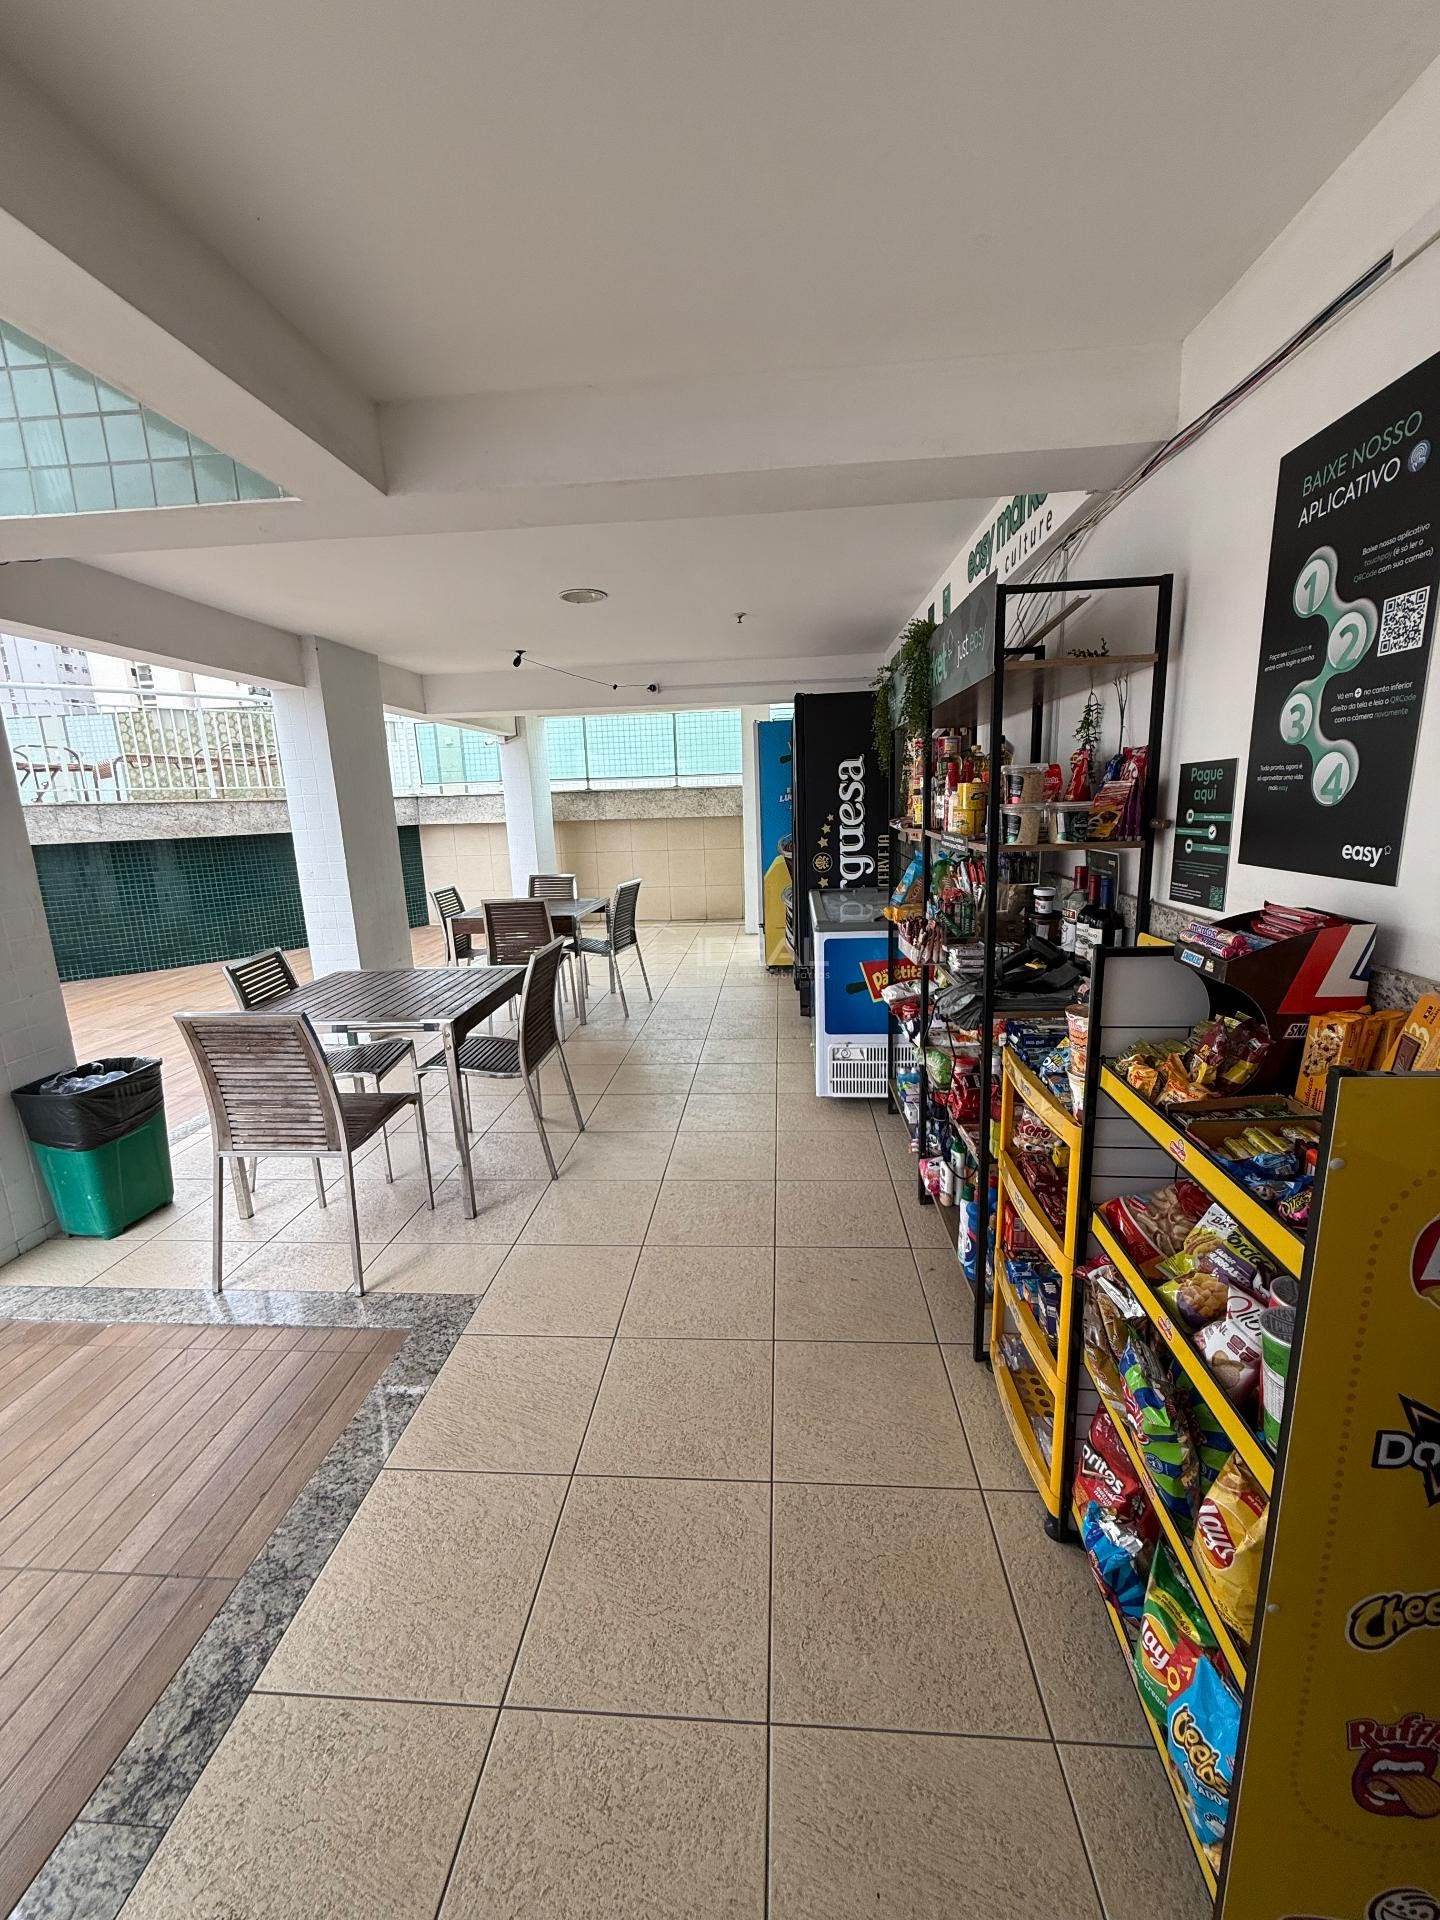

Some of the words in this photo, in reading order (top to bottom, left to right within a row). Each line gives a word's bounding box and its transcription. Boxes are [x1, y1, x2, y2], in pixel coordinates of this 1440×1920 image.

[1303, 454, 1349, 497] BAIXE
[1352, 411, 1423, 469] NOSSO
[1298, 457, 1401, 528] APLICATIVO
[967, 522, 996, 584] easy
[1005, 509, 1053, 574] culture
[1379, 537, 1397, 549] nosso
[1397, 523, 1431, 542] aplicativo
[1378, 564, 1392, 574] com
[1393, 560, 1404, 569] sua
[1303, 570, 1319, 614] 1
[1334, 622, 1361, 667] 2
[1363, 688, 1372, 696] no
[1390, 681, 1414, 691] inferior
[1289, 702, 1307, 742] 3
[1191, 767, 1224, 785] Pague
[1193, 784, 1217, 805] aqui
[1319, 762, 1344, 801] 4
[1341, 844, 1383, 868] easy
[1190, 922, 1217, 940] mentos
